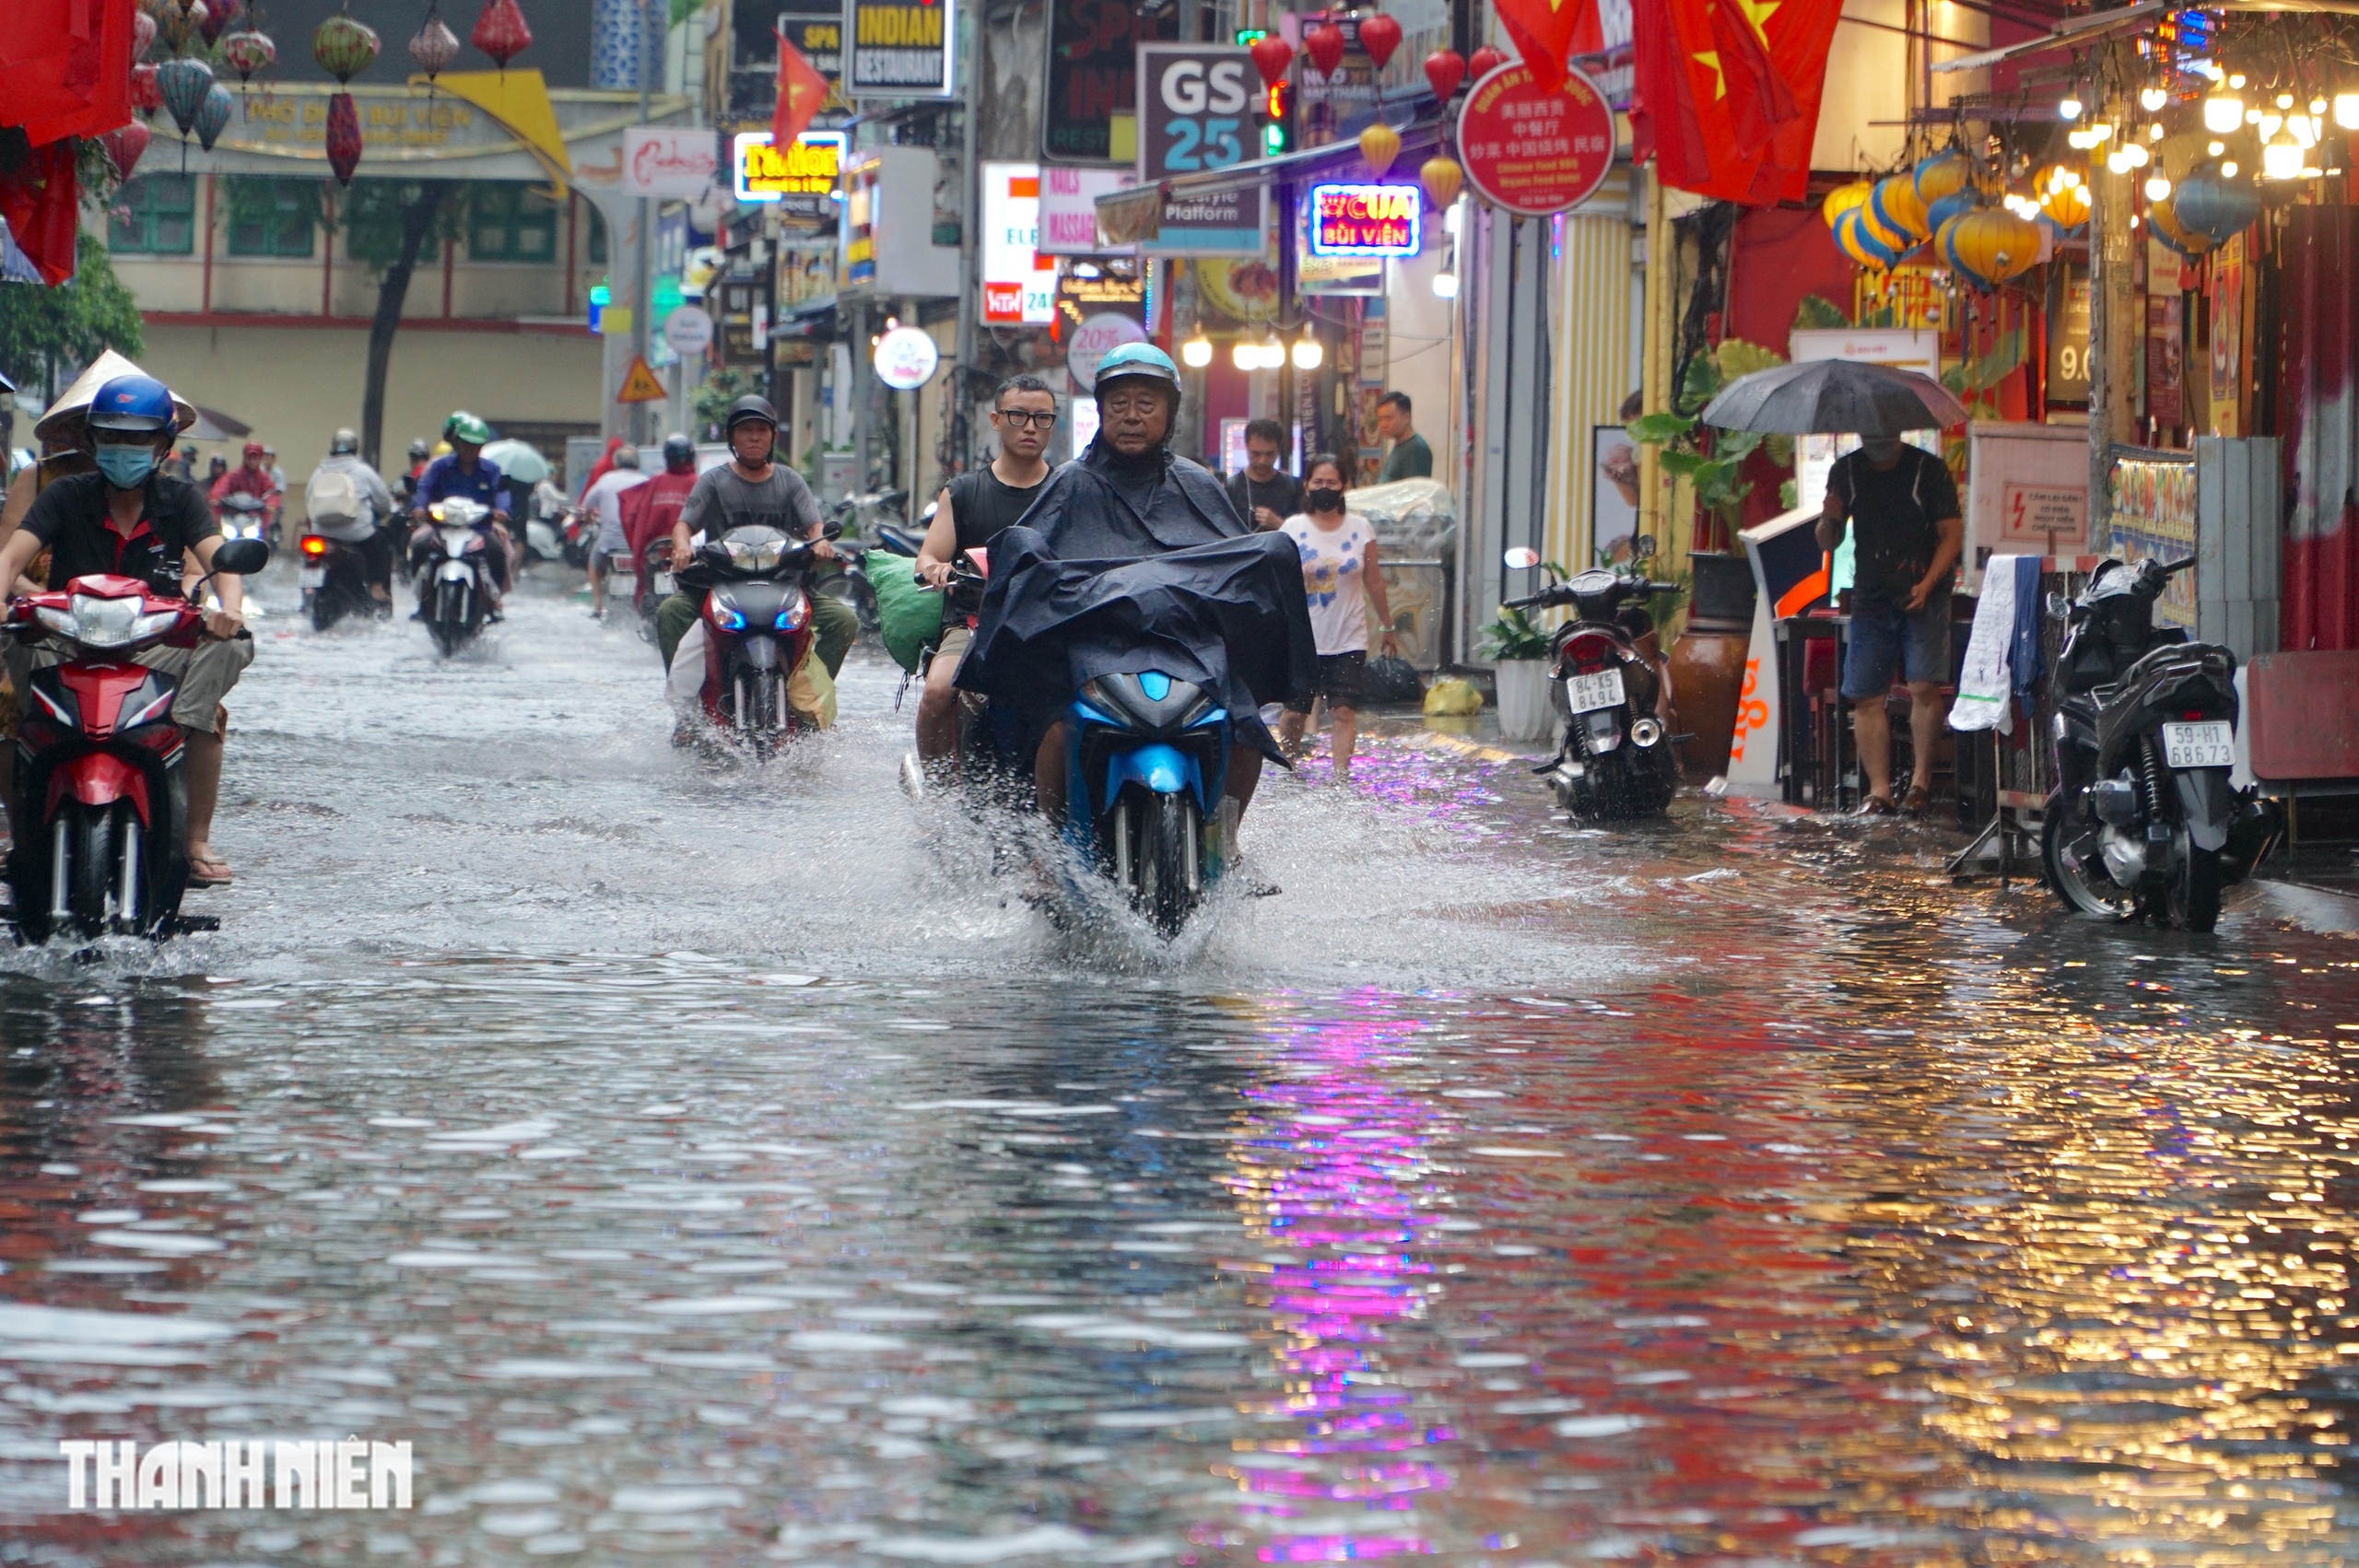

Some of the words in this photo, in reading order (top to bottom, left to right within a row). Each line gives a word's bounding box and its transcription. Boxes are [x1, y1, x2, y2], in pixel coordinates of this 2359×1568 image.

[858, 6, 942, 45] INDIAN
[804, 25, 839, 49] SPA
[855, 51, 942, 84] RESTAURANT
[1161, 59, 1246, 114] GS
[1501, 99, 1565, 120] 美丽西贡
[1512, 119, 1559, 137] 中餐厅
[1164, 118, 1242, 171] 25
[1496, 160, 1533, 174] Chinese
[1535, 159, 1557, 171] Food
[1532, 175, 1555, 185] Food
[1165, 205, 1238, 221] Platform
[1322, 220, 1356, 245] BÙI
[1575, 675, 1614, 693] 84-K5
[1578, 692, 1616, 709] 8494
[2174, 726, 2220, 744] 59-H1
[2171, 745, 2231, 765] 686.73
